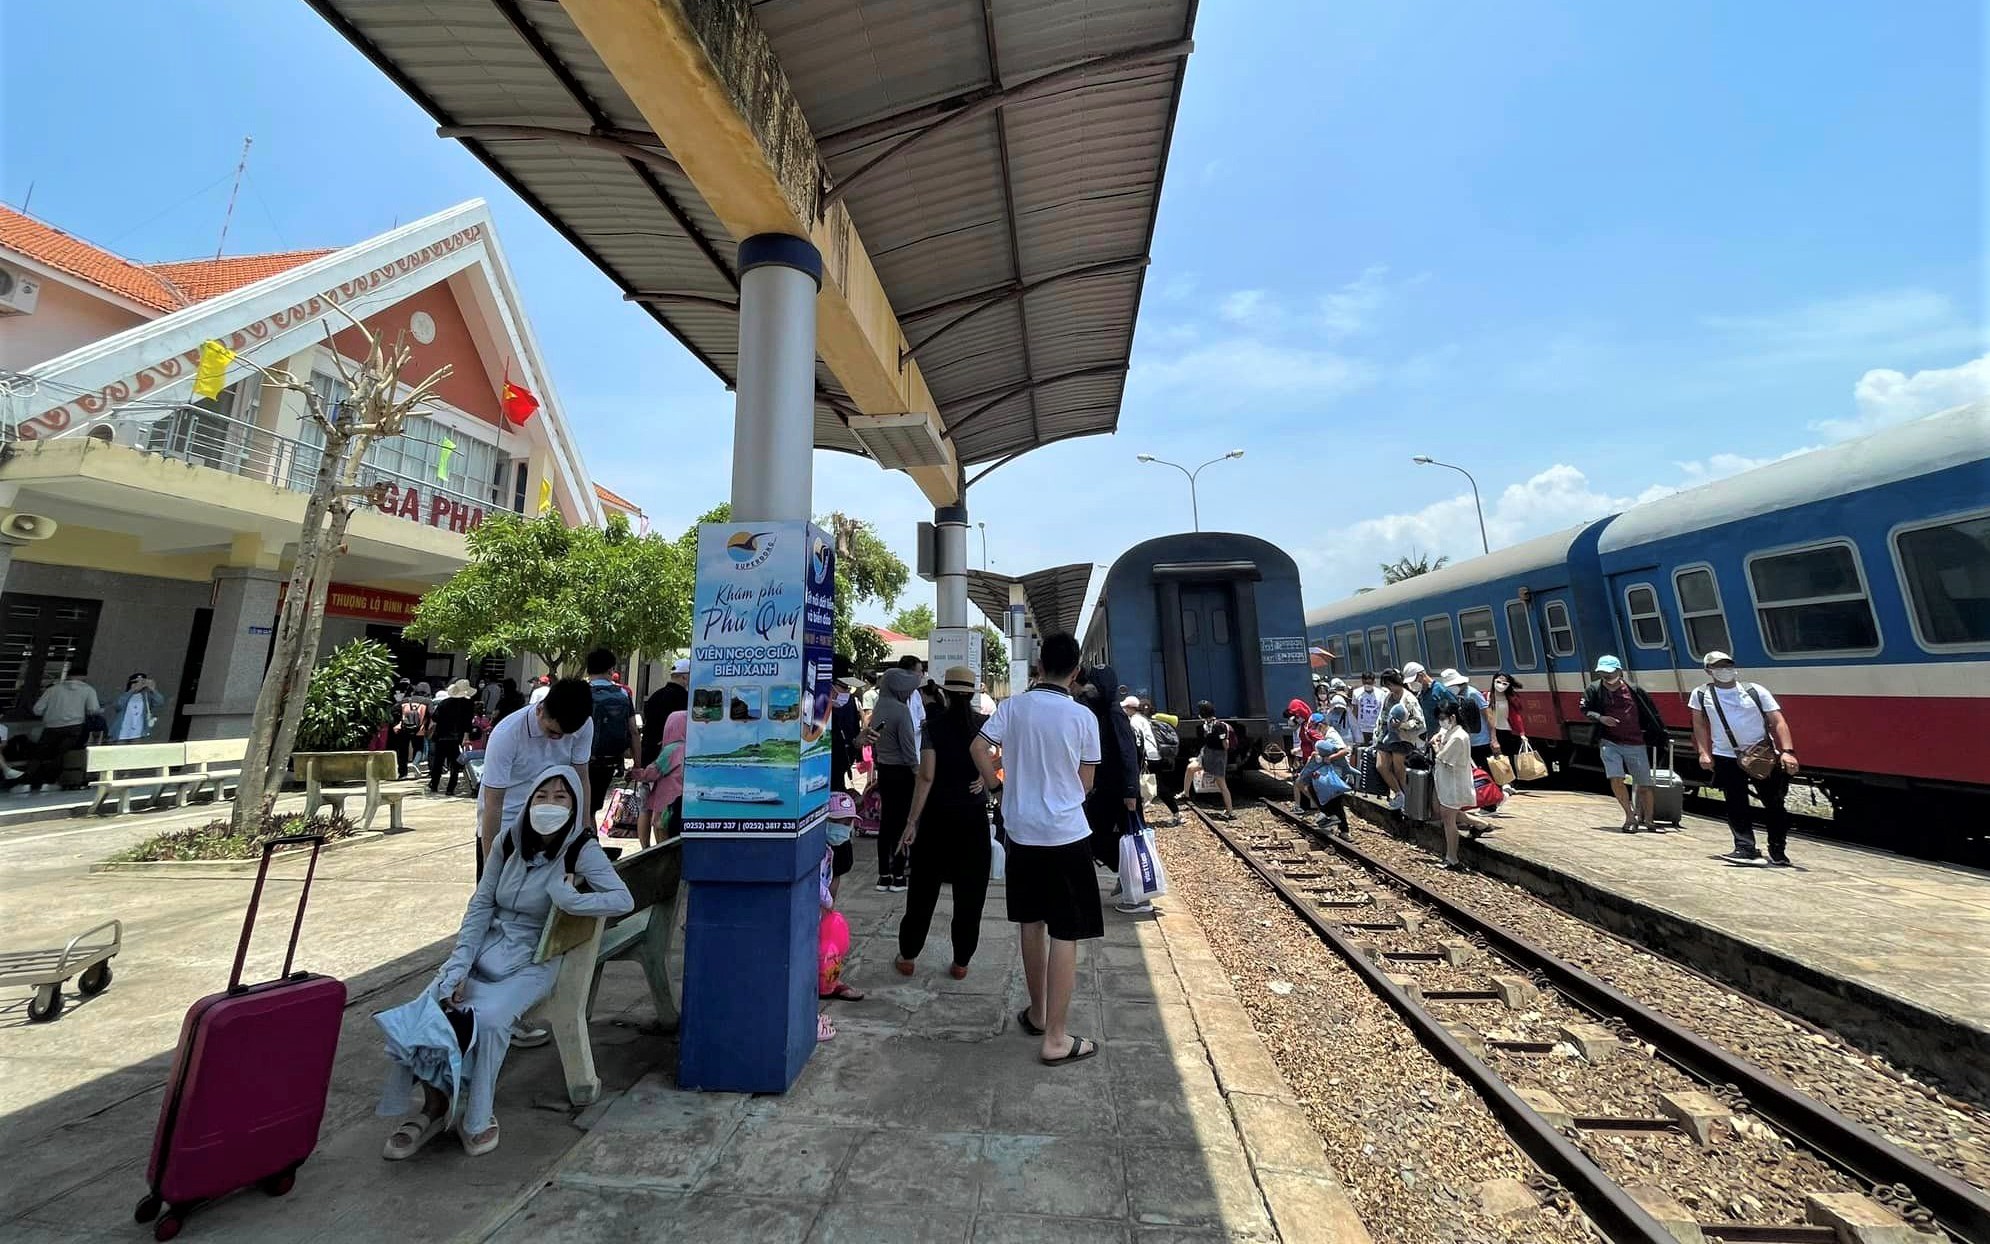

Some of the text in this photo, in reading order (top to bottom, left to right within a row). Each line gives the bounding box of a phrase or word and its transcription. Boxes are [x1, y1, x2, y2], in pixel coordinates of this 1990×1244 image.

[374, 481, 419, 522] GA
[716, 580, 784, 607] Khám phá
[383, 599, 402, 613] BÌNH
[701, 600, 801, 641] Phú Quý
[696, 643, 799, 663] VIÊN NGỌC GIỮA
[742, 662, 779, 676] XANH
[683, 821, 796, 831] (0252) 3817 337 (0252) 3817 338
